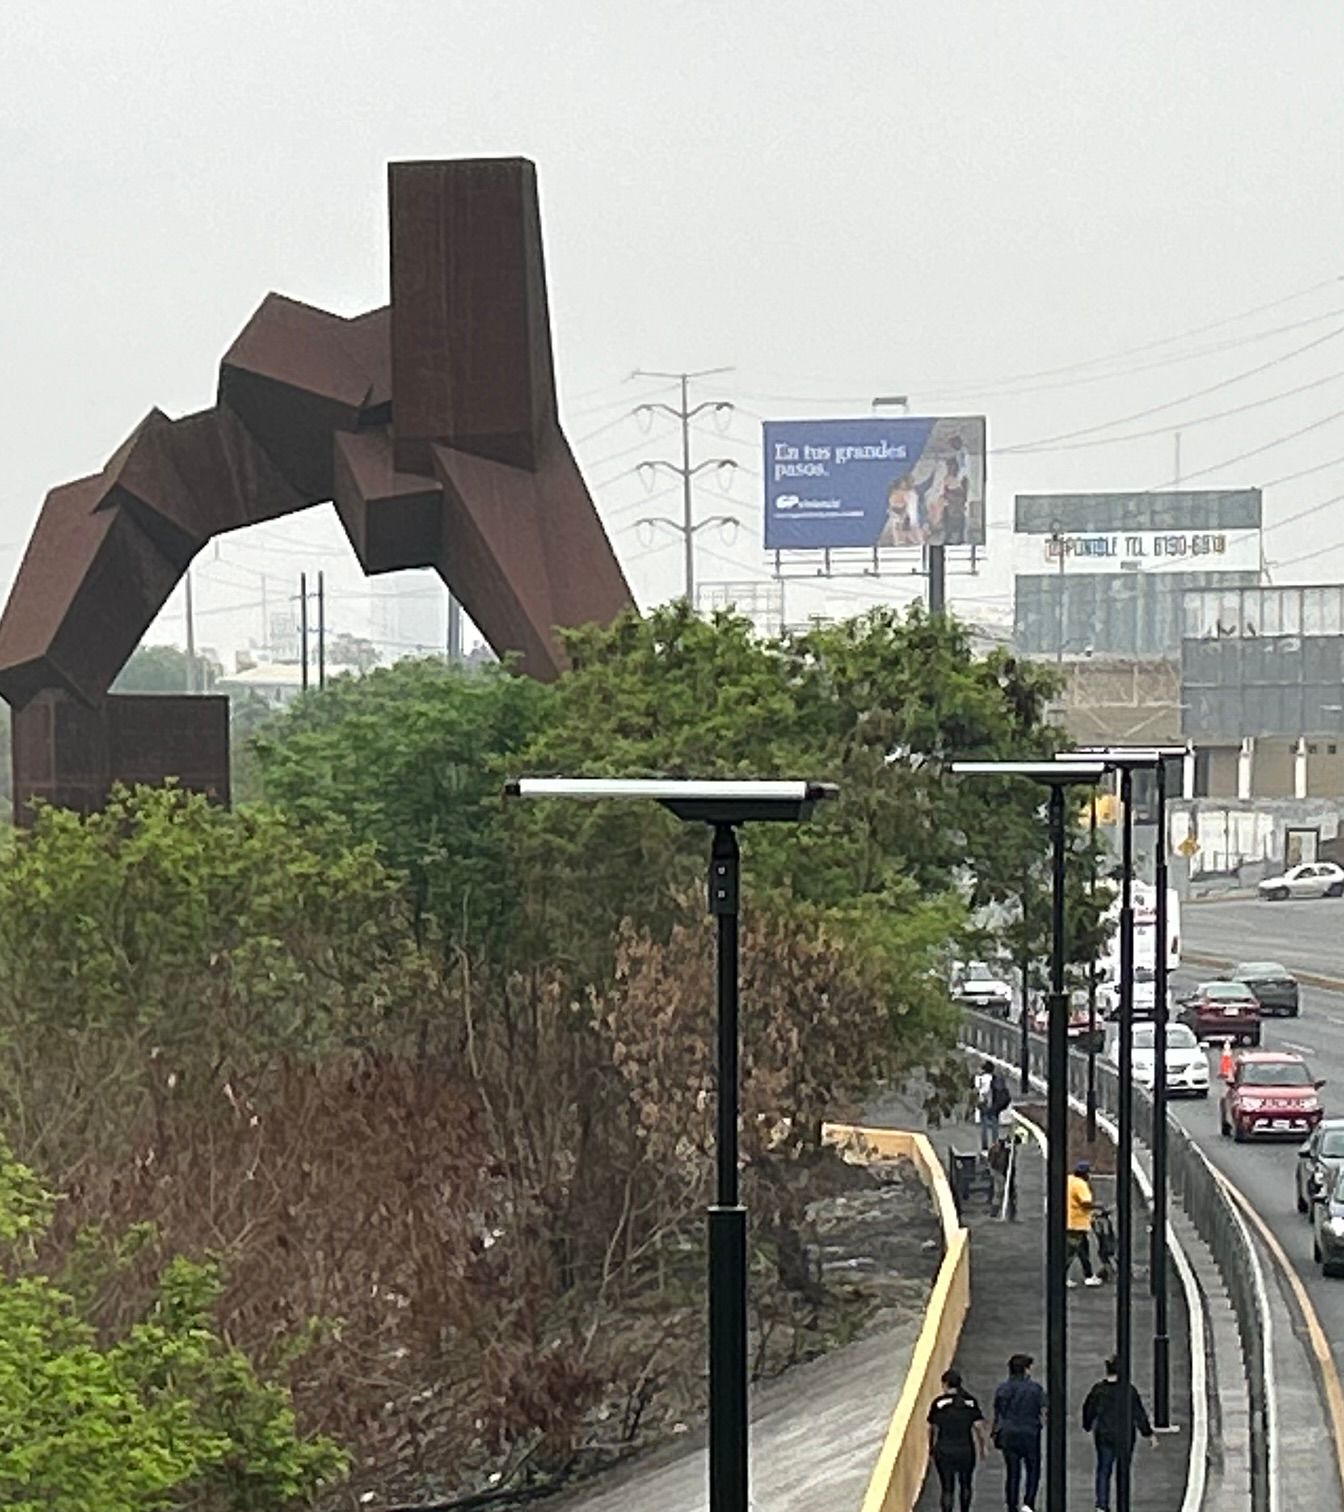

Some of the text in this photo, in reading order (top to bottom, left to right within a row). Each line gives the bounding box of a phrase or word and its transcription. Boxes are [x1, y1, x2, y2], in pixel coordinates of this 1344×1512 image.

[774, 440, 907, 464] En tus grandes
[774, 462, 831, 481] pasos.
